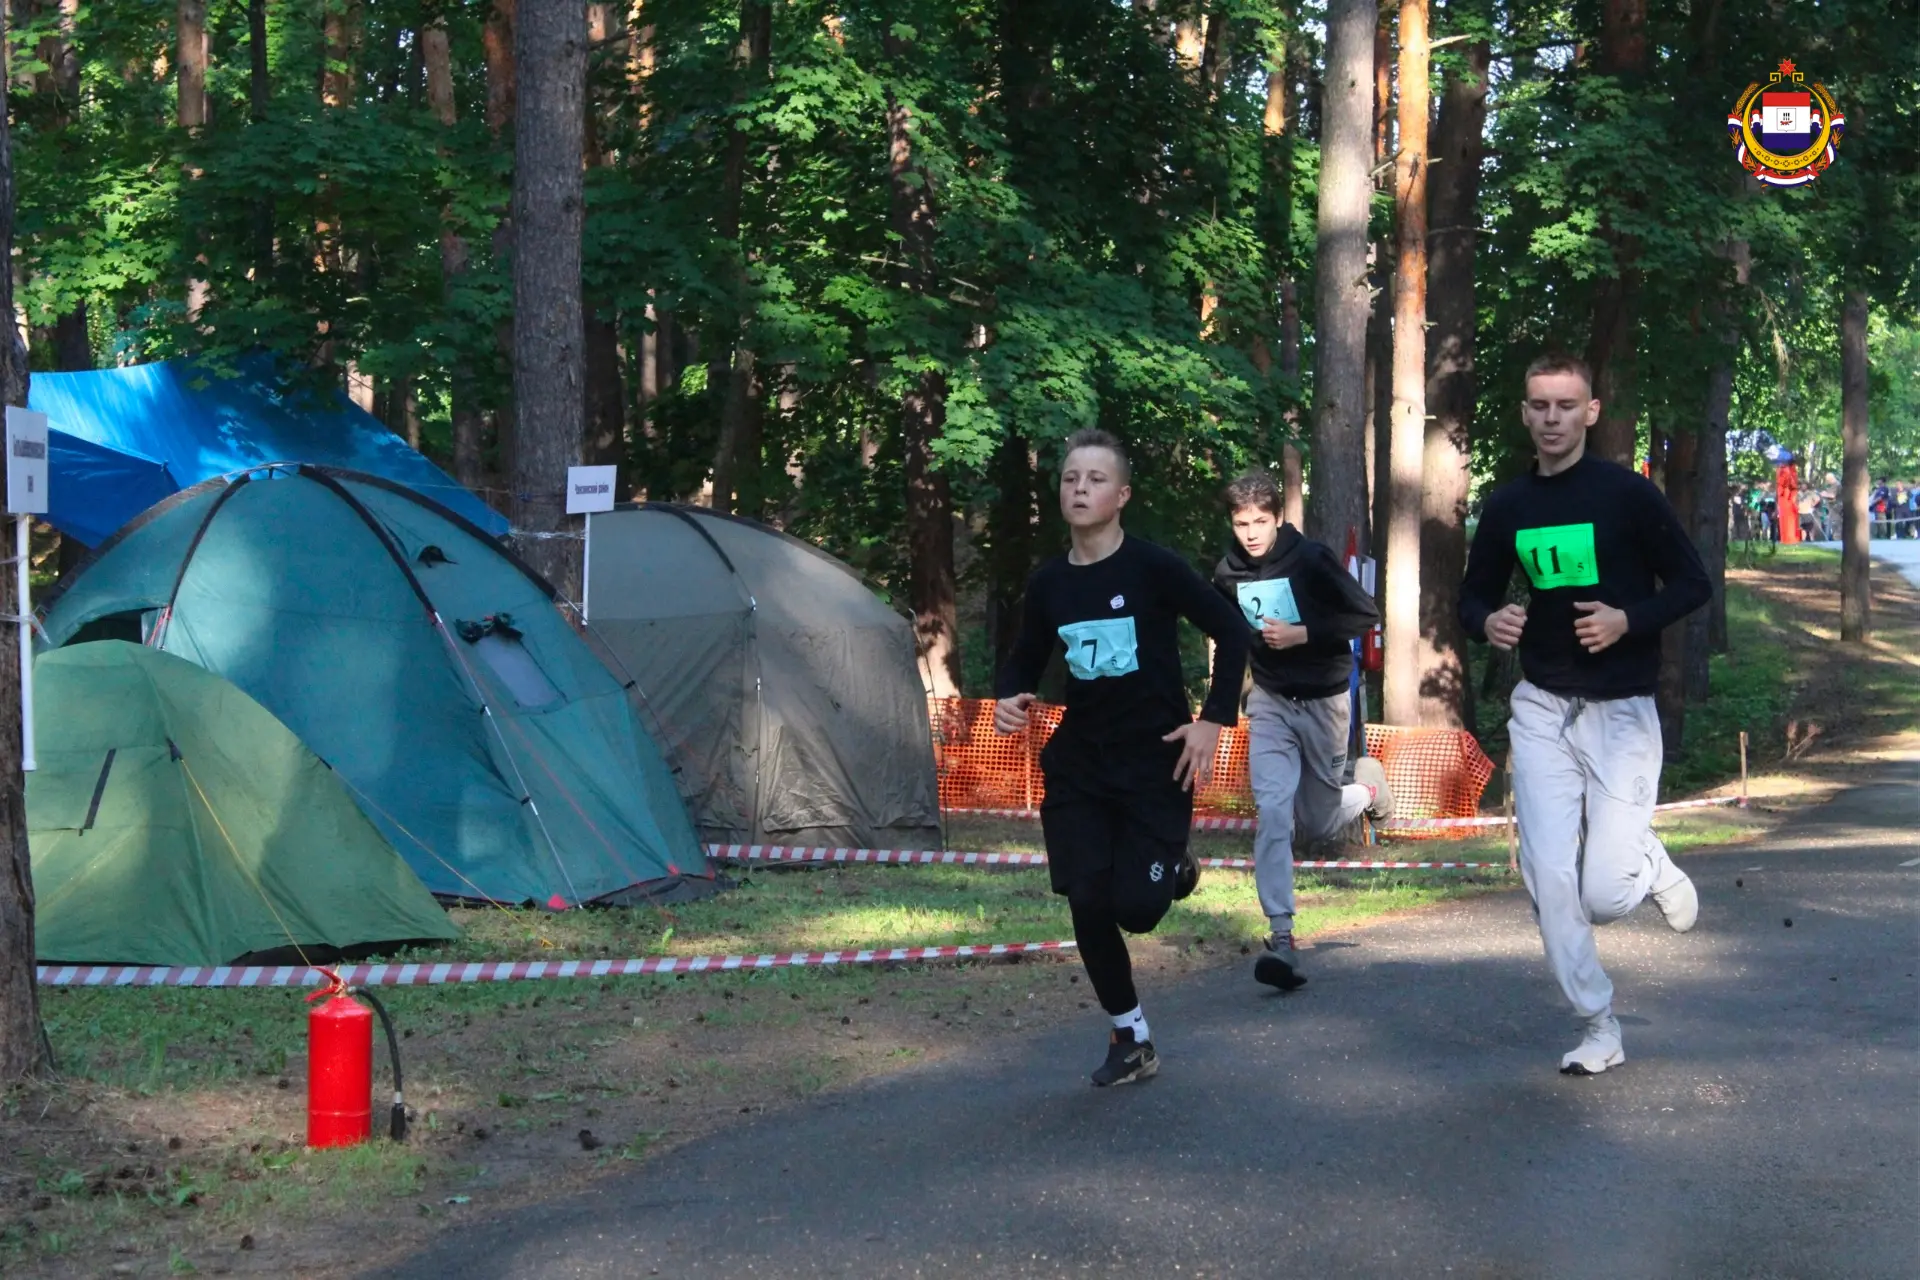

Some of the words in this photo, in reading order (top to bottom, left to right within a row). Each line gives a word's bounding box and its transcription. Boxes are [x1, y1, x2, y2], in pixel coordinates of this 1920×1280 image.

[1529, 545, 1565, 576] 11
[1577, 562, 1584, 573] 5
[1251, 596, 1264, 620] 2
[1081, 638, 1098, 669] 7
